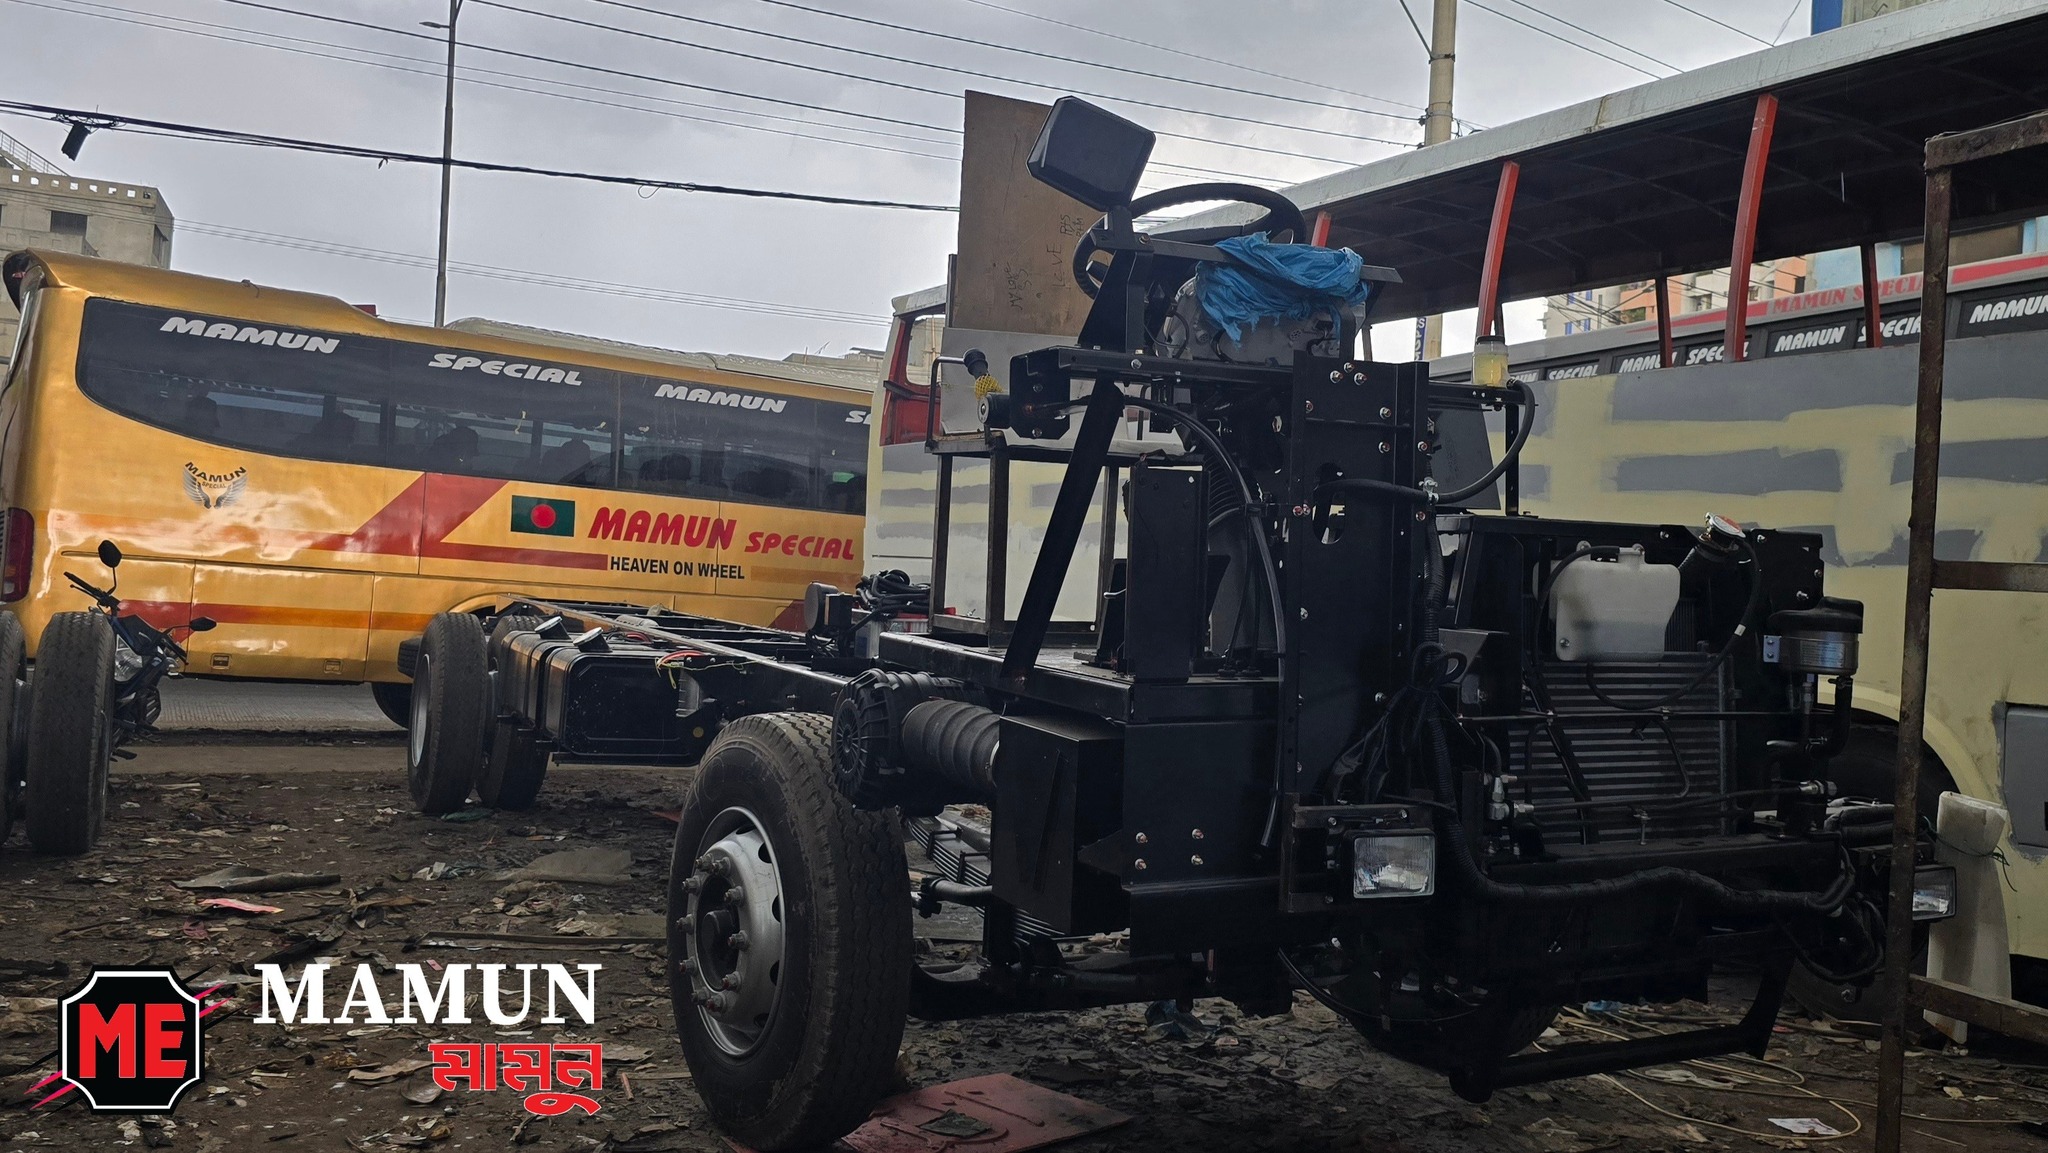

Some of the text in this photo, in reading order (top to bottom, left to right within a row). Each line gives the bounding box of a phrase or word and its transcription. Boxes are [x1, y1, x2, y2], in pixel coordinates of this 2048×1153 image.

[1773, 288, 1847, 314] MAMUN
[159, 316, 341, 354] MAMUN
[1774, 326, 1847, 352] MAMUN
[1685, 341, 1750, 366] SPECL
[428, 353, 583, 386] SPECIAL
[654, 383, 787, 413] MAMUN
[185, 461, 247, 483] MAMUN
[202, 481, 227, 489] SPECIAL
[588, 506, 855, 561] MAMUN SPECIAL
[610, 556, 745, 580] HEAVEN ON WHEEL
